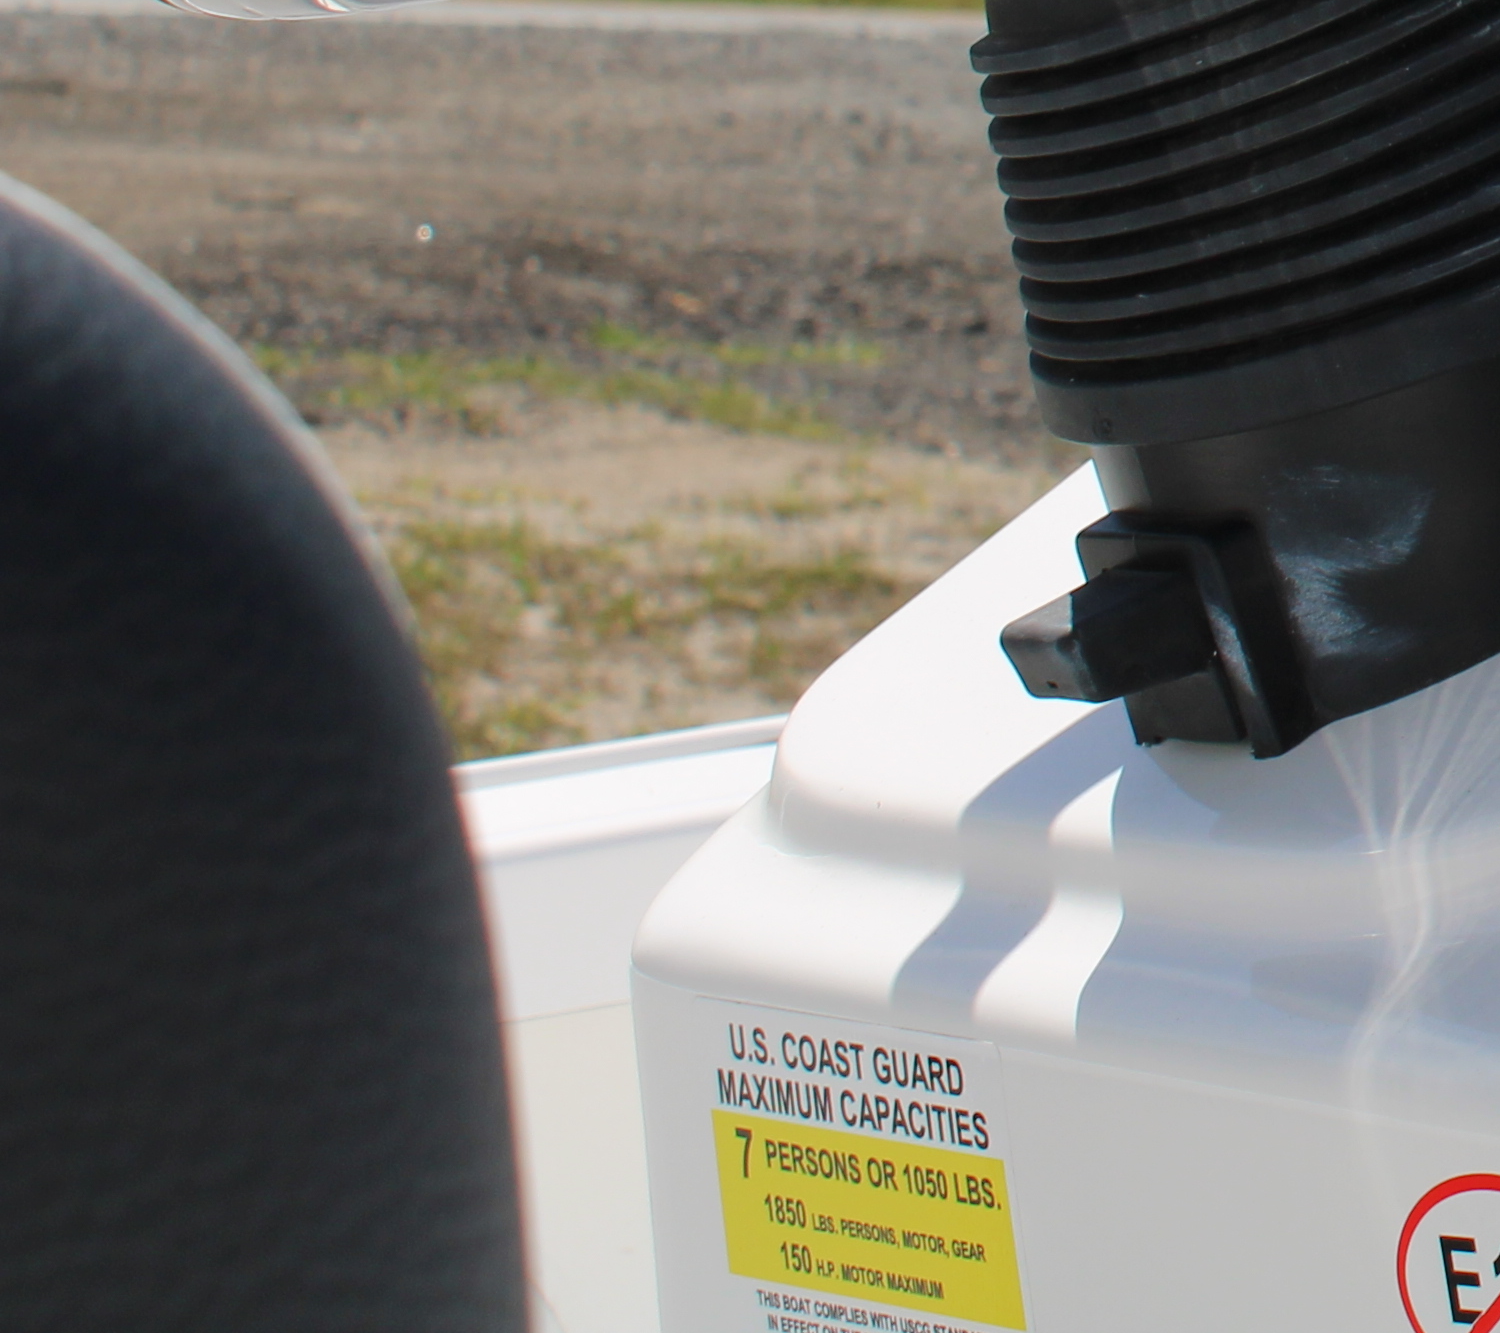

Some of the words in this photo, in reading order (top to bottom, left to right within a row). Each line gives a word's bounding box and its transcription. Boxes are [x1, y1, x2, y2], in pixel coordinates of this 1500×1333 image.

[729, 1023, 775, 1066] U.S.
[782, 1032, 865, 1080] COAST
[873, 1046, 964, 1096] GUARD
[717, 1068, 834, 1123] MAXIMUM
[841, 1089, 989, 1150] CAPACITIES
[735, 1127, 752, 1178] 7
[765, 1139, 862, 1184] PERSONS
[867, 1158, 898, 1192] OR
[903, 1163, 948, 1200] 1050
[953, 1173, 1002, 1210] LBS.
[765, 1194, 807, 1229] 1850
[812, 1213, 838, 1234] LBS.
[840, 1219, 900, 1249] PERSONS,
[902, 1230, 950, 1258] MOTOR,
[952, 1240, 987, 1262] GEAR
[781, 1241, 812, 1275] 150
[817, 1259, 839, 1280] H.P.
[842, 1264, 886, 1288] MOTOR
[887, 1272, 945, 1299] MAXIMUM
[757, 1289, 780, 1309] THIS
[783, 1294, 812, 1315] BOAT
[814, 1300, 869, 1326] COMPLIES
[870, 1310, 898, 1331] WITH
[767, 1314, 779, 1331] IN
